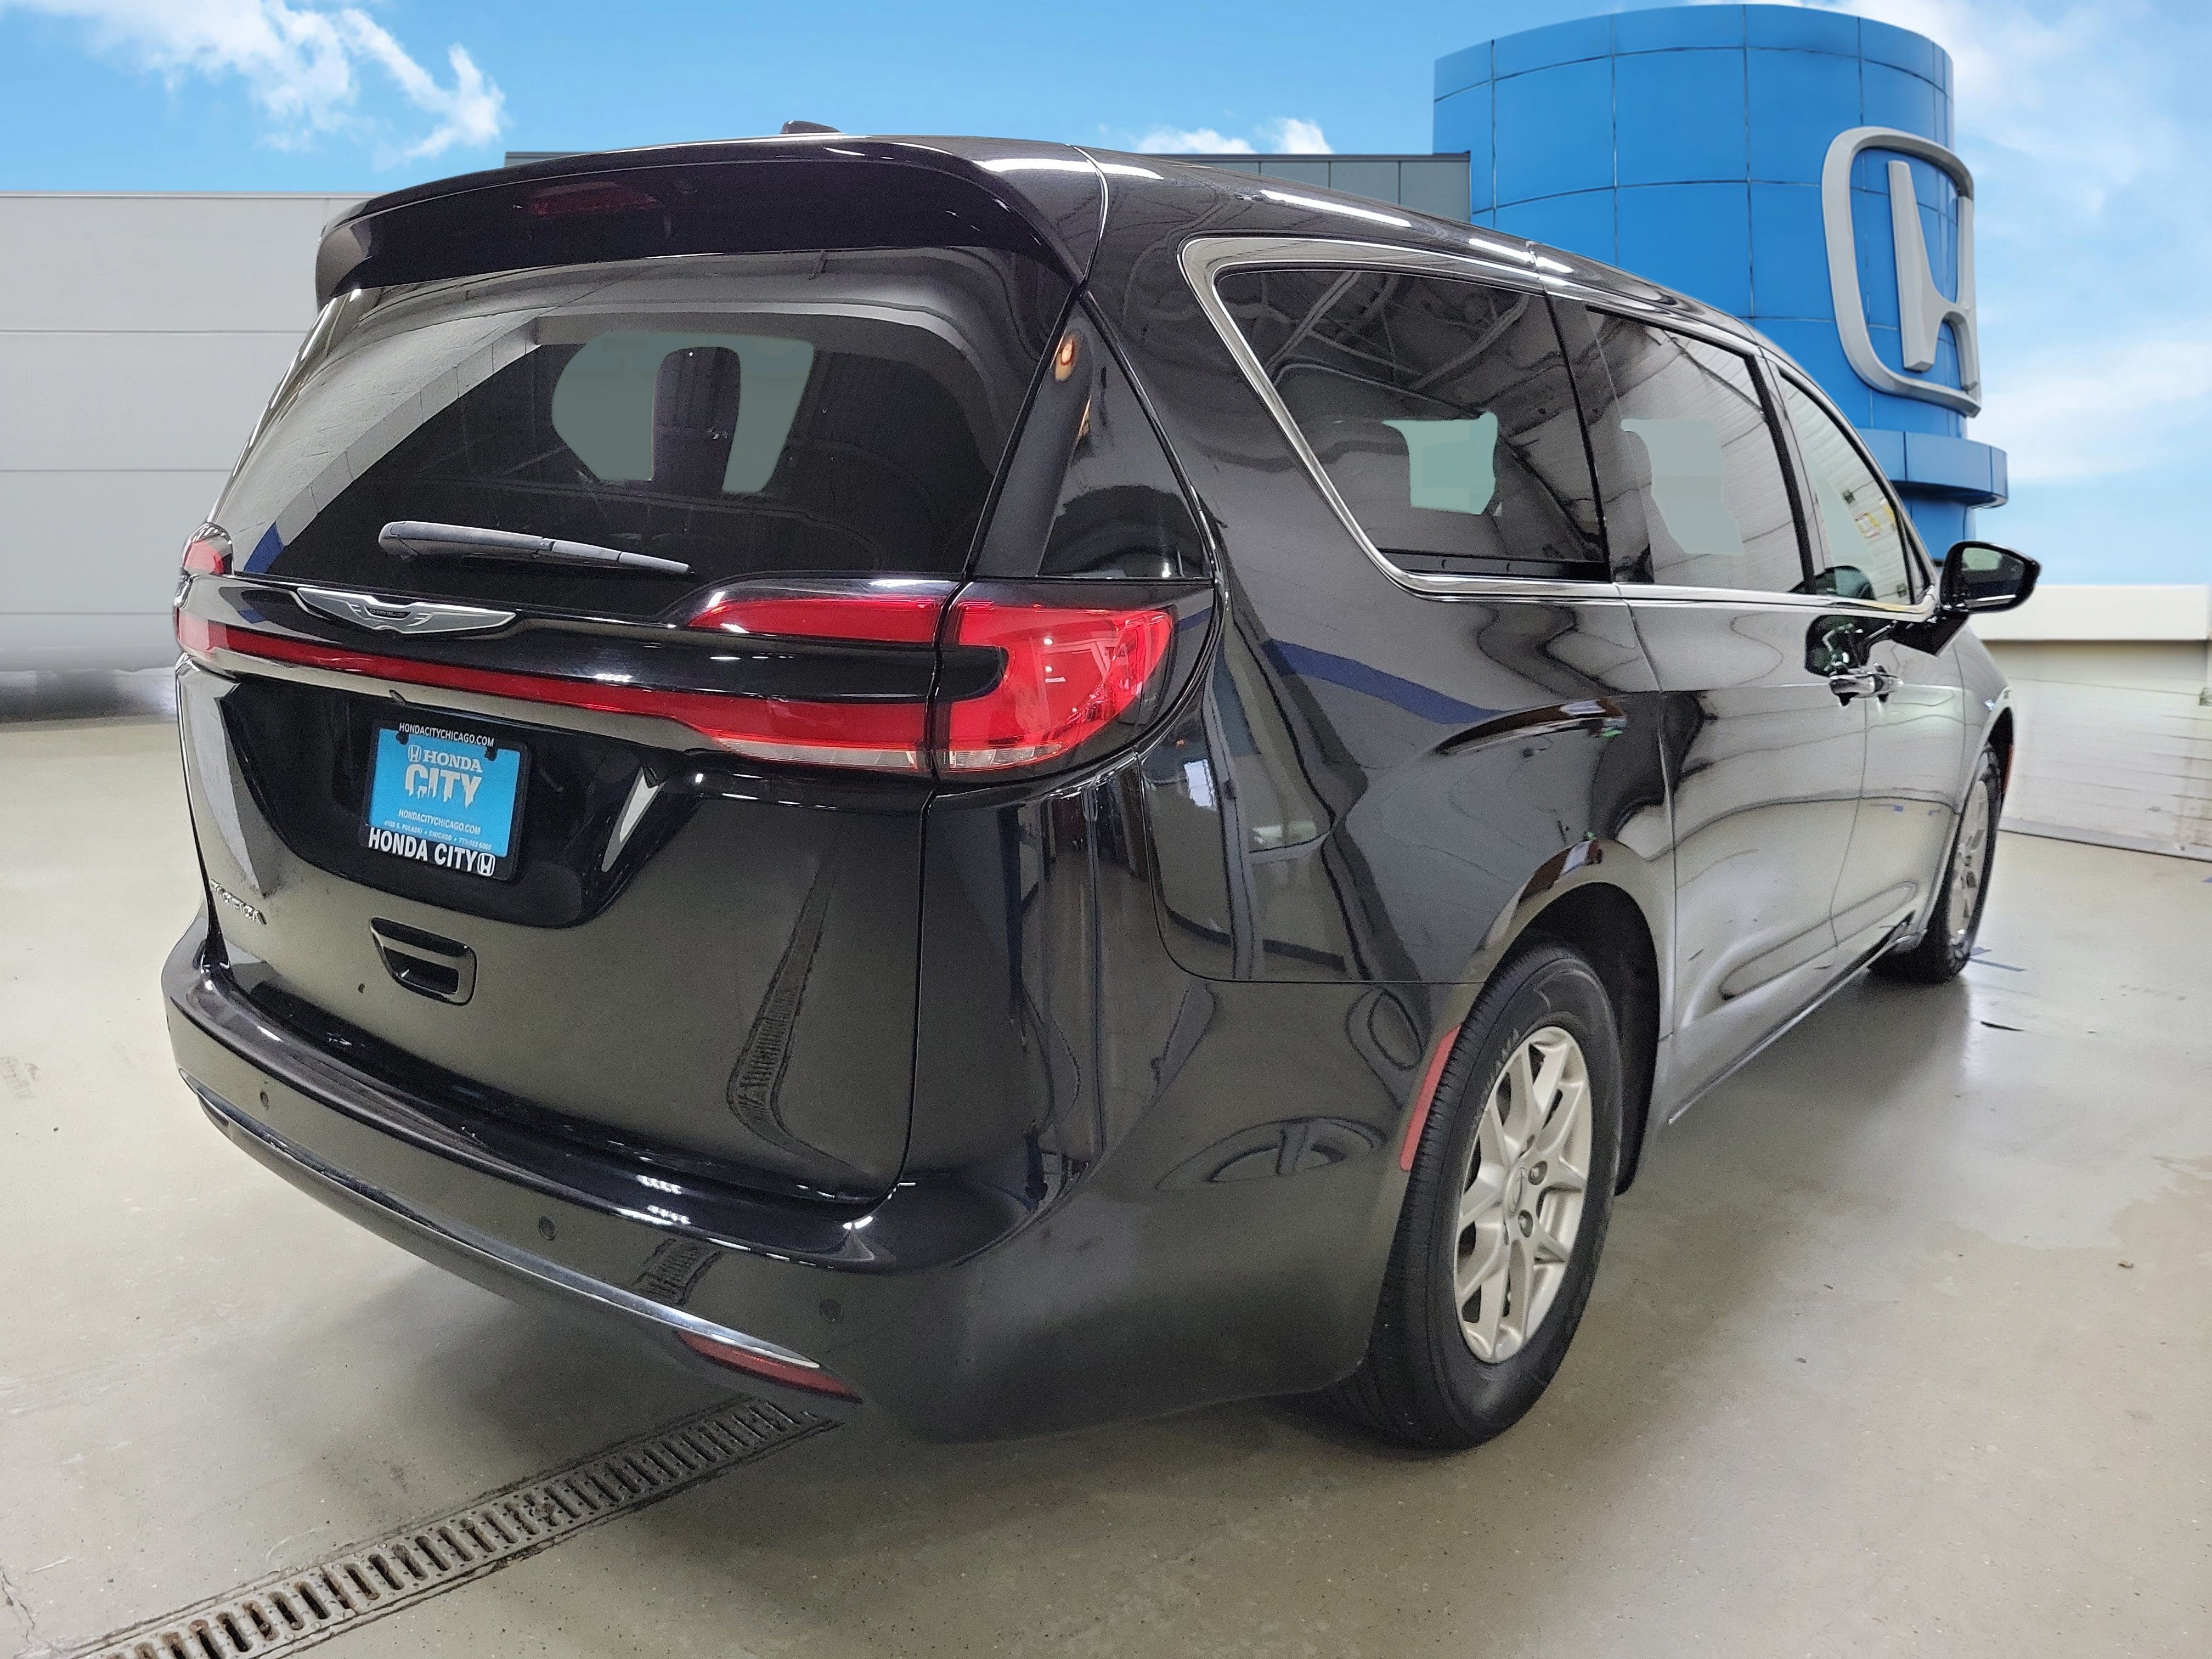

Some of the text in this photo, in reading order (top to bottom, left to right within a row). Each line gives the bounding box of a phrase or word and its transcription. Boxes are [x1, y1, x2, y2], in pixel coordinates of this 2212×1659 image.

[399, 722, 494, 747] HONDACITYCHICAGO.COM
[423, 749, 483, 773] HONDA
[405, 763, 483, 808] CITY
[398, 809, 481, 835] HONDACITYCHICAGO.COM
[429, 830, 452, 841] CHICAGO
[368, 827, 428, 862] HONDA
[434, 843, 478, 872] CITY
